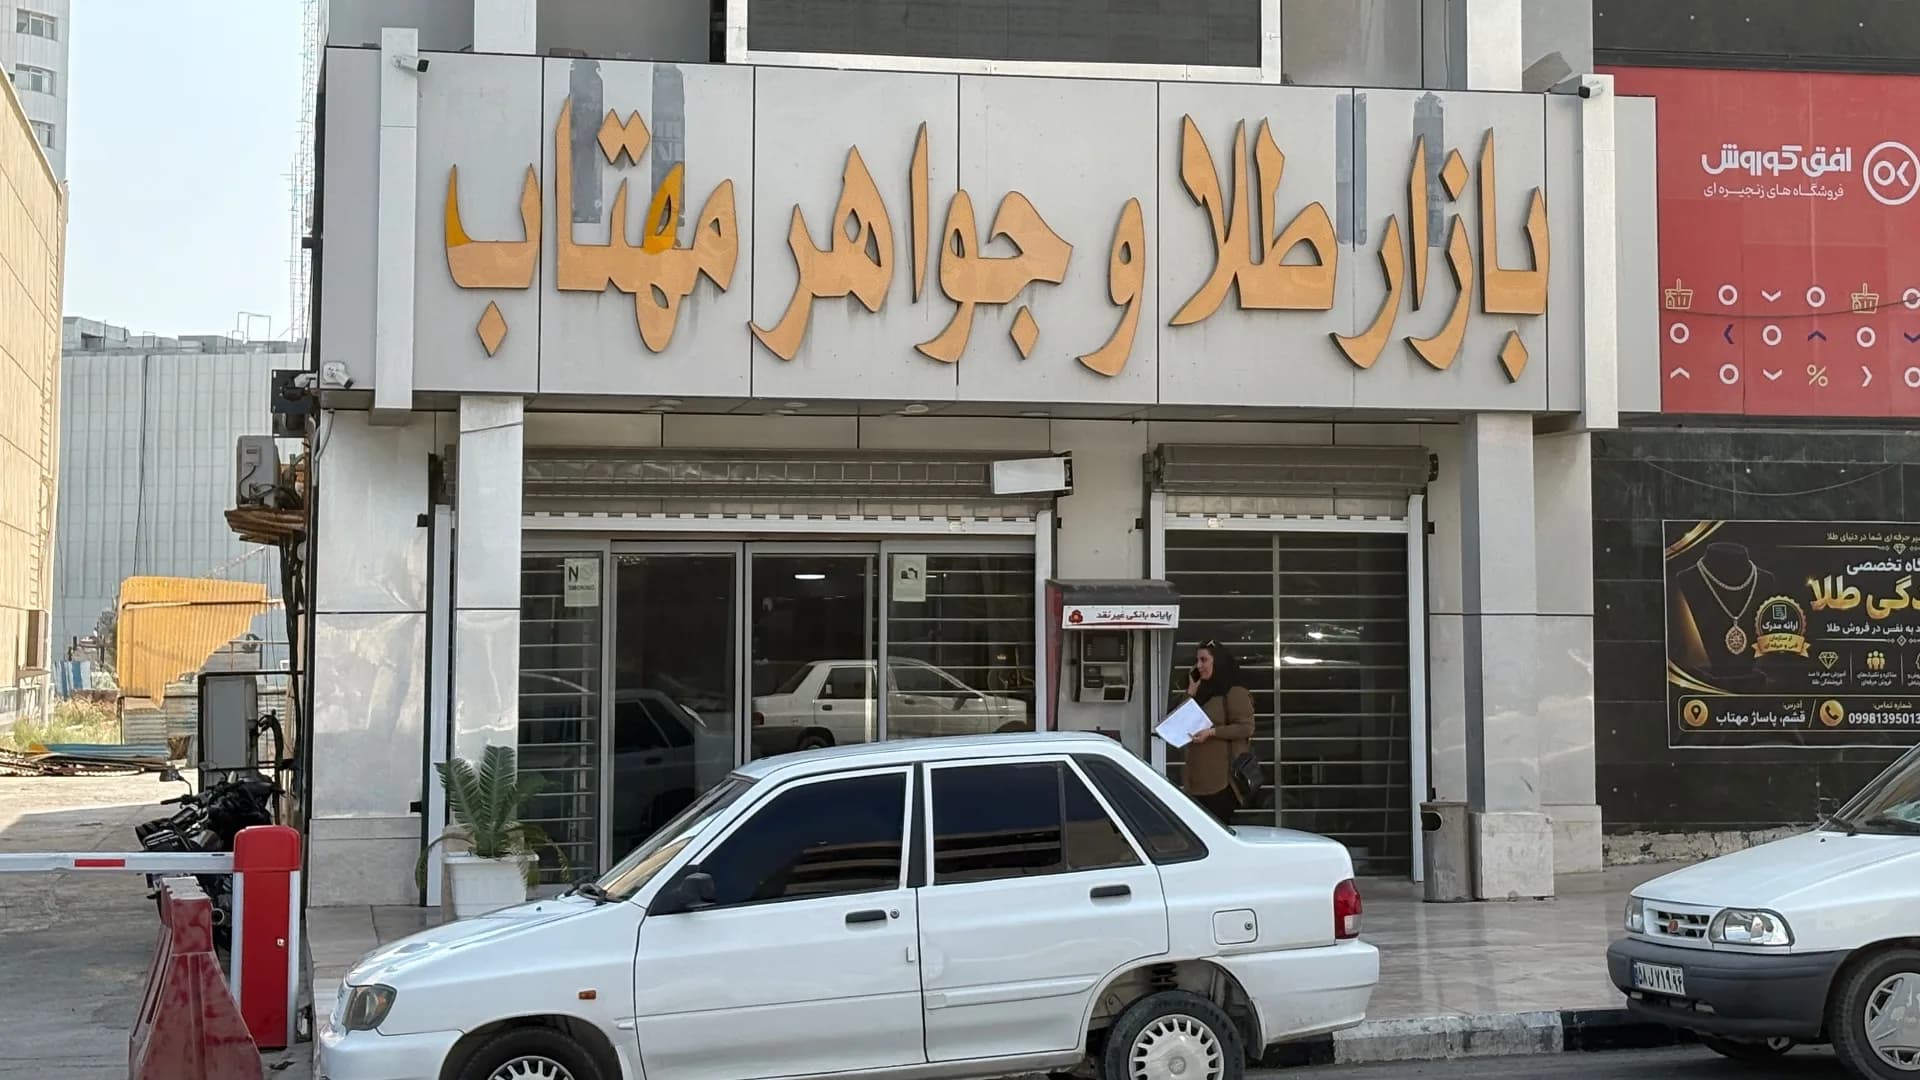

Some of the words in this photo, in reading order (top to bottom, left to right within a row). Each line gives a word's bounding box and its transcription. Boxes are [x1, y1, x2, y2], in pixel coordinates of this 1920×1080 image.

[1701, 144, 1802, 177] کوروش
[1801, 146, 1852, 178] افق
[1703, 182, 1717, 197] ای
[1718, 184, 1765, 199] زنجیره
[1766, 184, 1791, 199] های
[1792, 183, 1845, 200] فروشگاه
[445, 94, 738, 357] مهتاب
[1168, 113, 1338, 326] طلا
[748, 120, 1073, 363] جواهر
[1330, 127, 1549, 382] بازار
[1076, 197, 1145, 377] و
[1846, 558, 1902, 575] تخصصی
[1808, 575, 1861, 611] طلا
[1126, 610, 1149, 620] بانکی
[1150, 611, 1172, 621] پایانه
[1826, 622, 1840, 633] طلا
[1842, 622, 1870, 635] فروش
[1871, 624, 1881, 635] در
[1716, 711, 1749, 726] مهتاب
[1750, 710, 1777, 727] پاساژ
